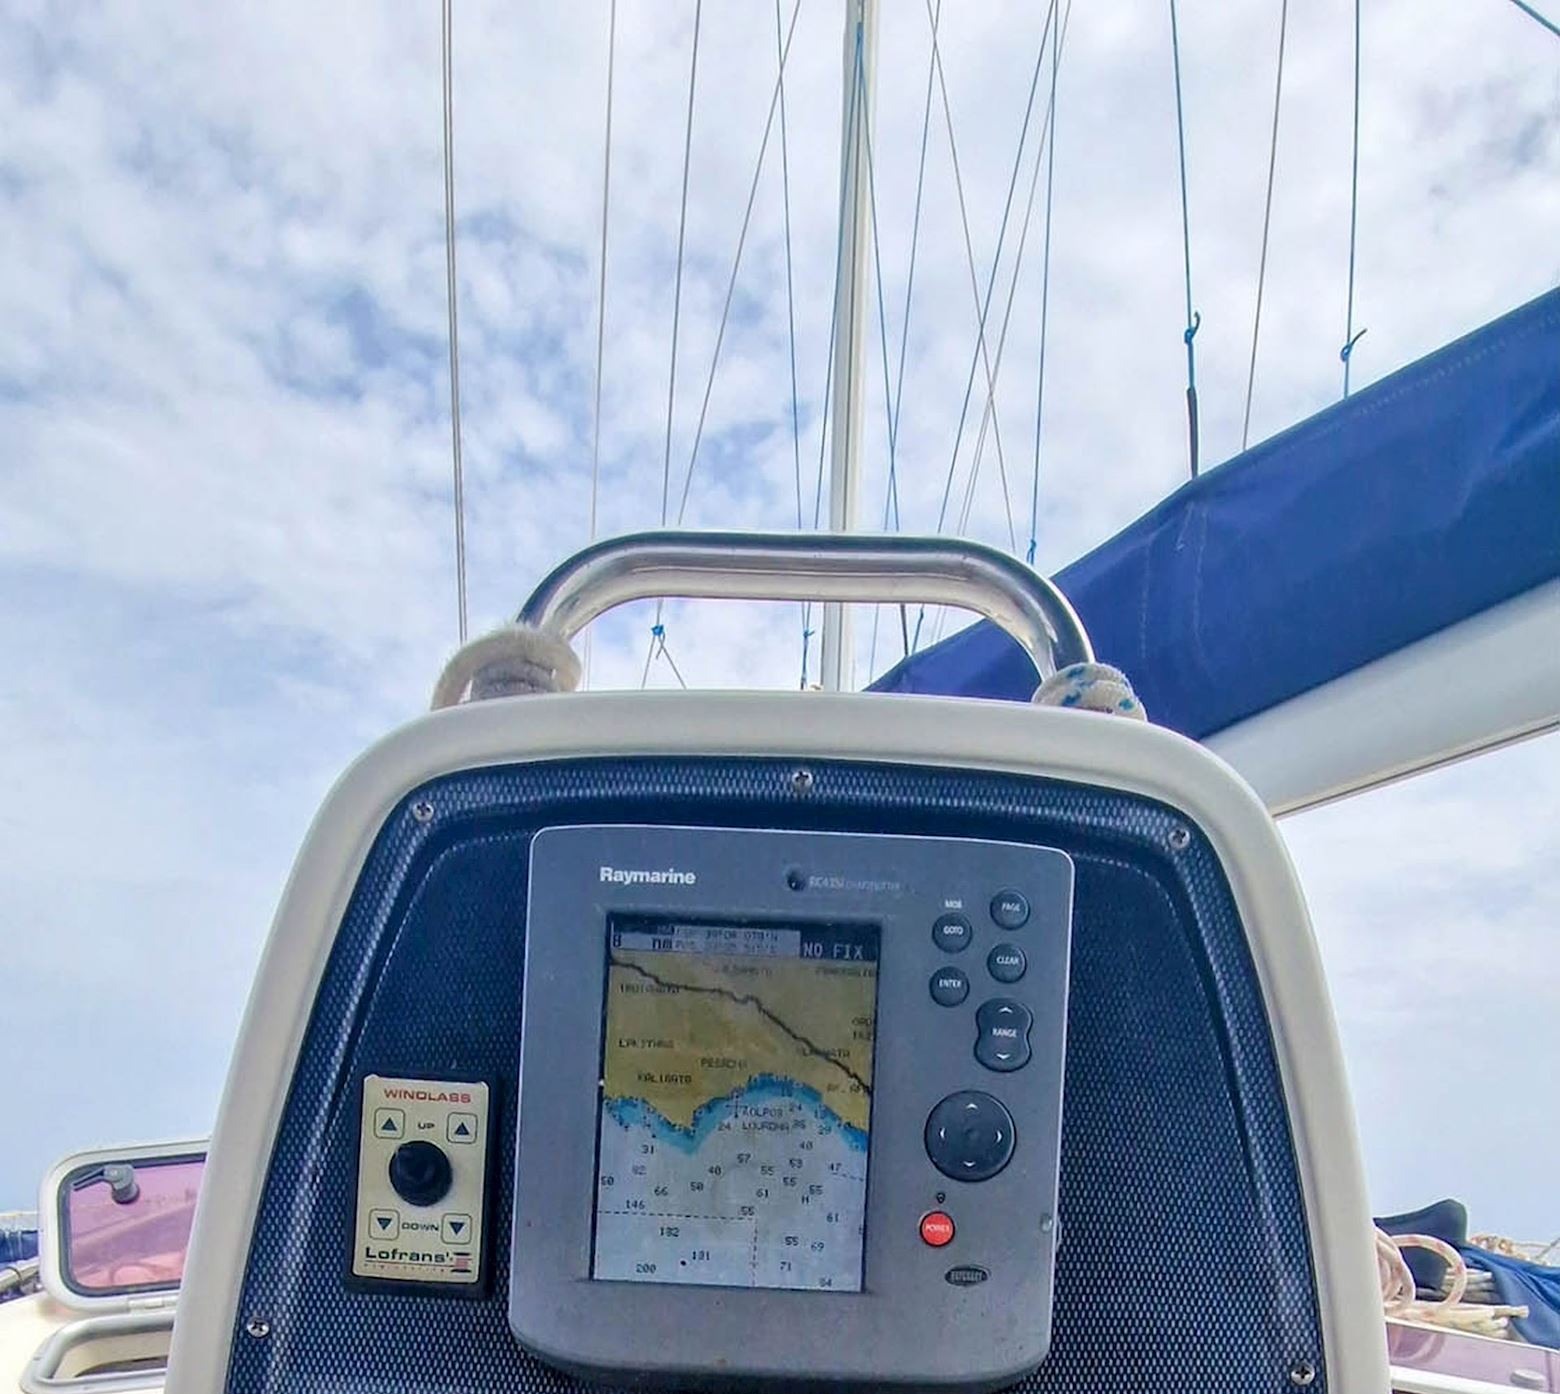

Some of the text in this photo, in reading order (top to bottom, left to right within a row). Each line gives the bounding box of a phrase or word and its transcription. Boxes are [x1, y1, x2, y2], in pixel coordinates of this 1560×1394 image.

[600, 866, 697, 885] Raymarine
[1001, 903, 1020, 912] PAGE
[943, 925, 963, 935] GOTO
[803, 942, 863, 959] NO FIX
[996, 955, 1019, 965] CLEAR
[939, 979, 962, 988] ENTER
[992, 1028, 1017, 1038] RANGE
[384, 1087, 471, 1104] WINDLASS
[417, 1121, 435, 1130] UP
[401, 1221, 440, 1232] DOWN
